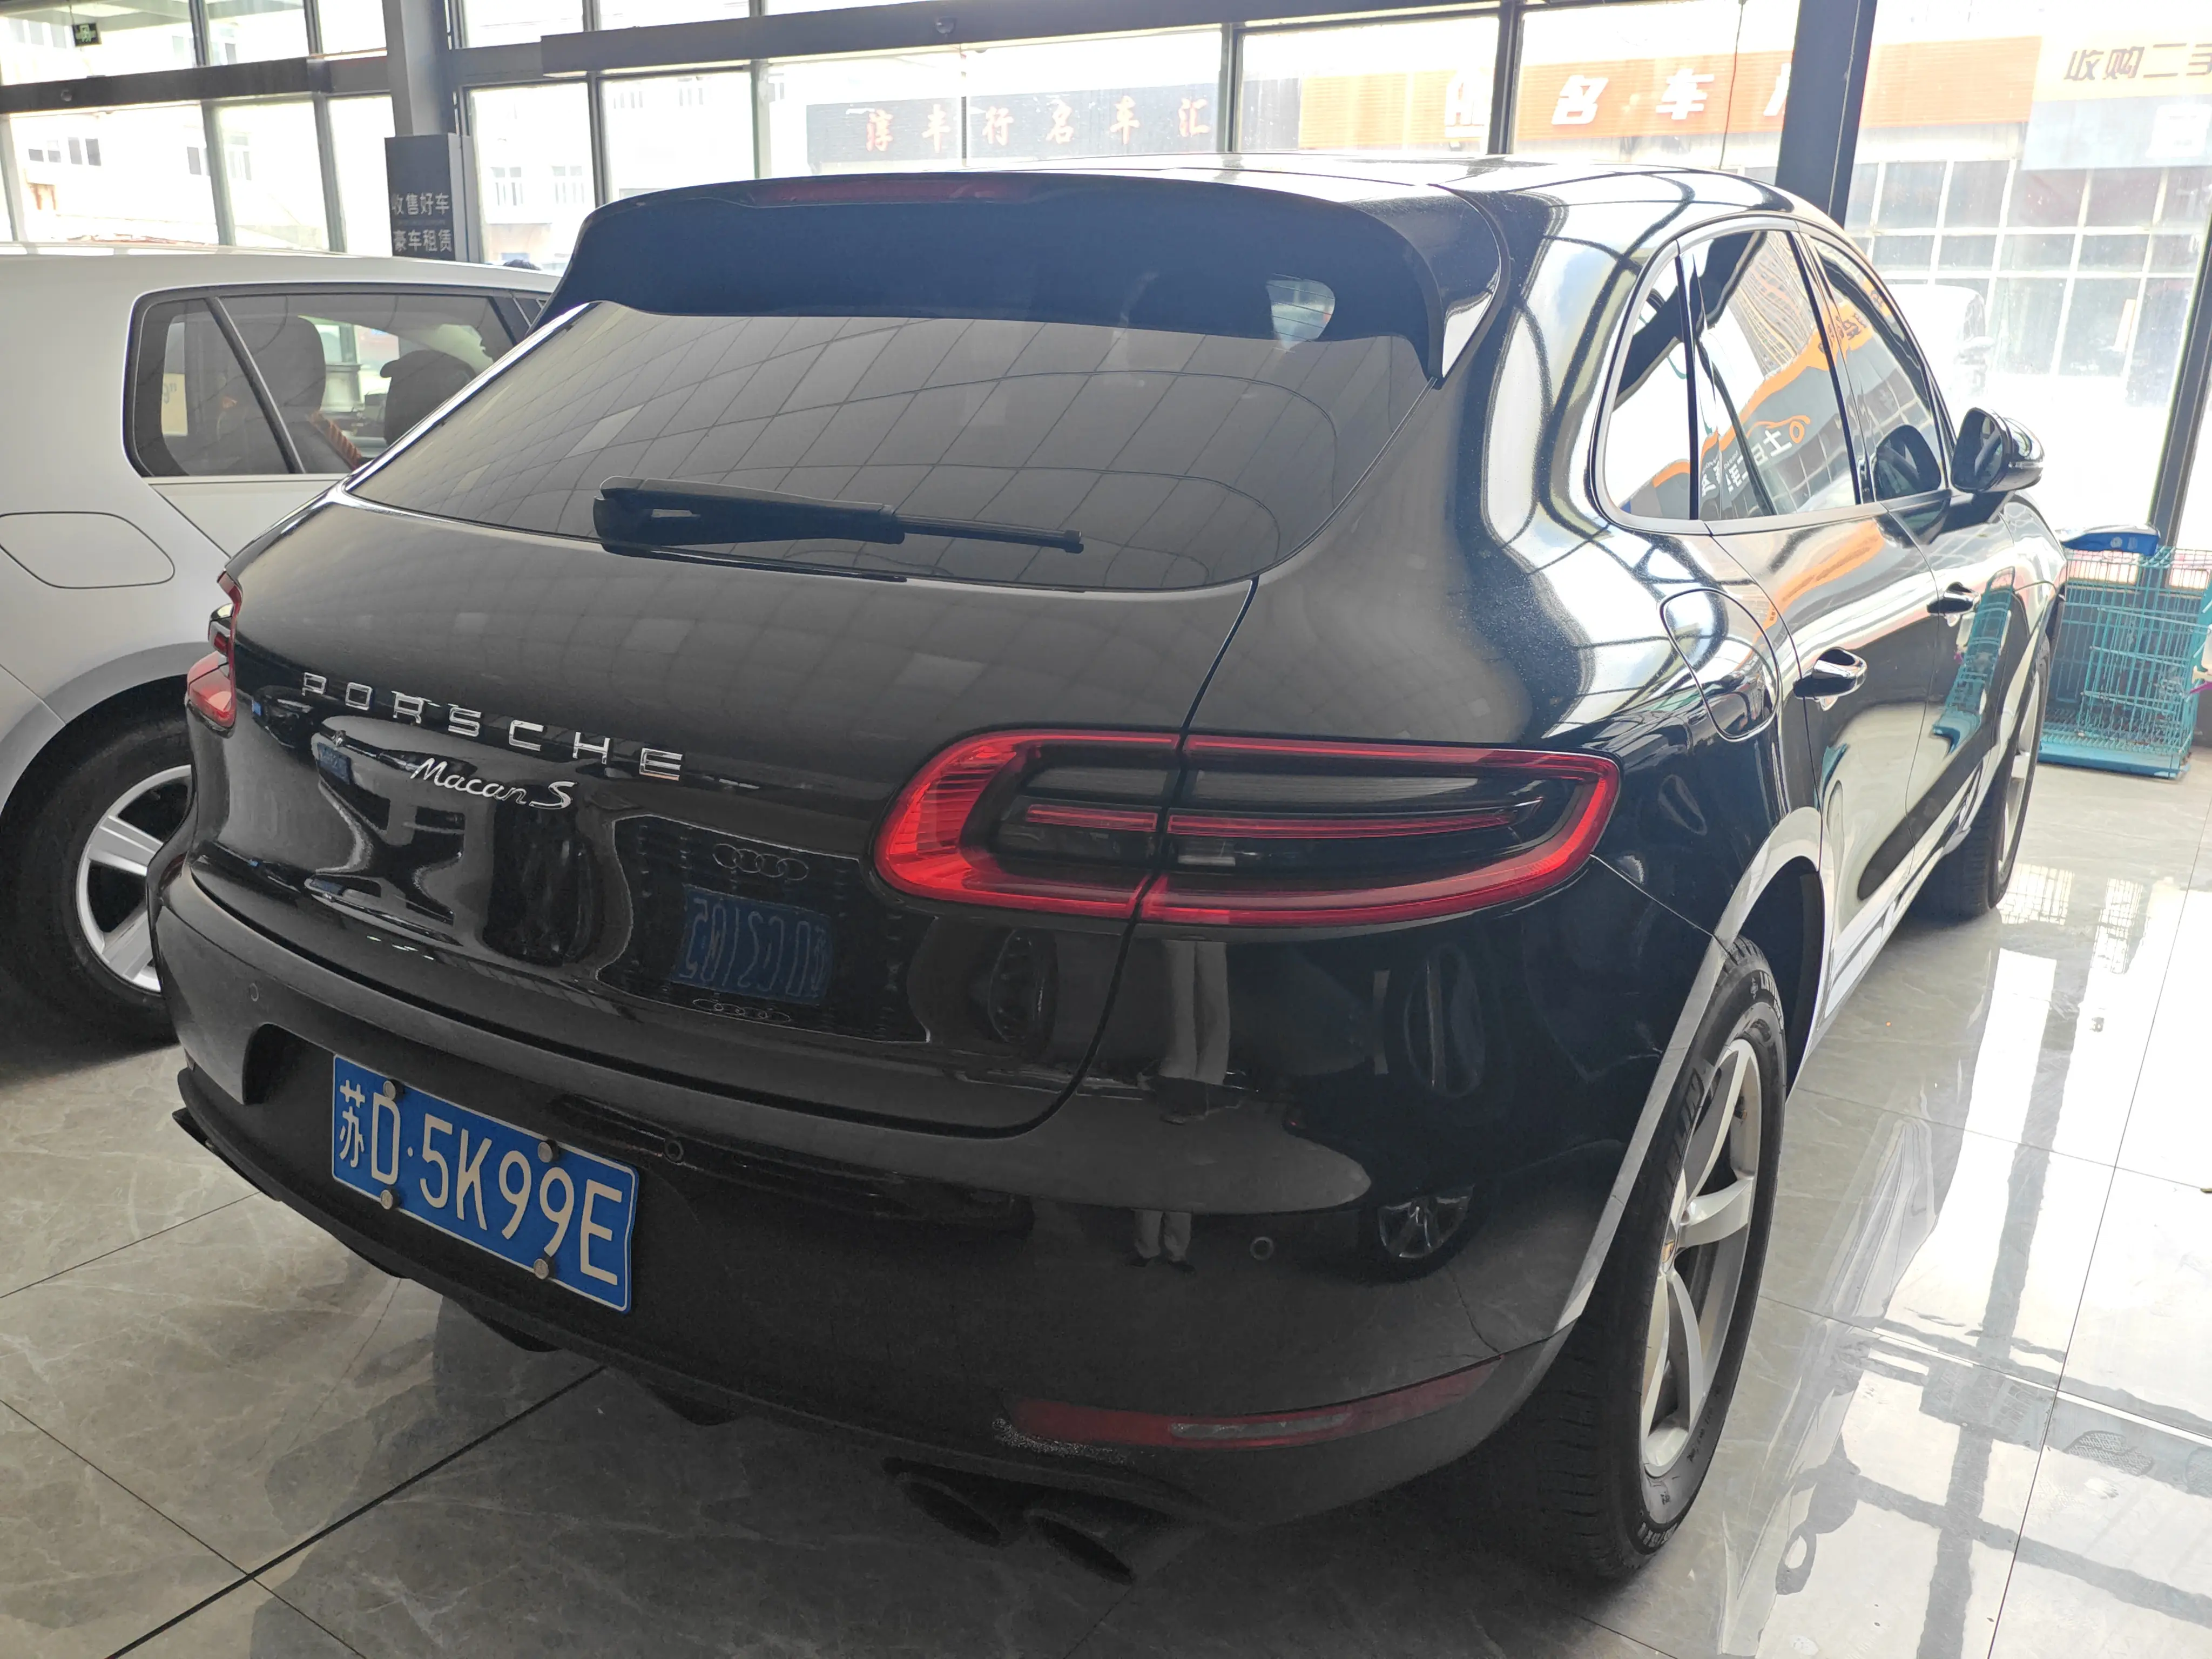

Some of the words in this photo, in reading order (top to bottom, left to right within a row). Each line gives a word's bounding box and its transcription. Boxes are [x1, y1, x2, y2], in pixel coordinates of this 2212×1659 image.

[391, 192, 450, 215] 收售好车
[393, 228, 453, 252] 豪车租赁
[301, 672, 684, 781] PORSCHE
[409, 758, 528, 806] Macan
[529, 781, 578, 810] S
